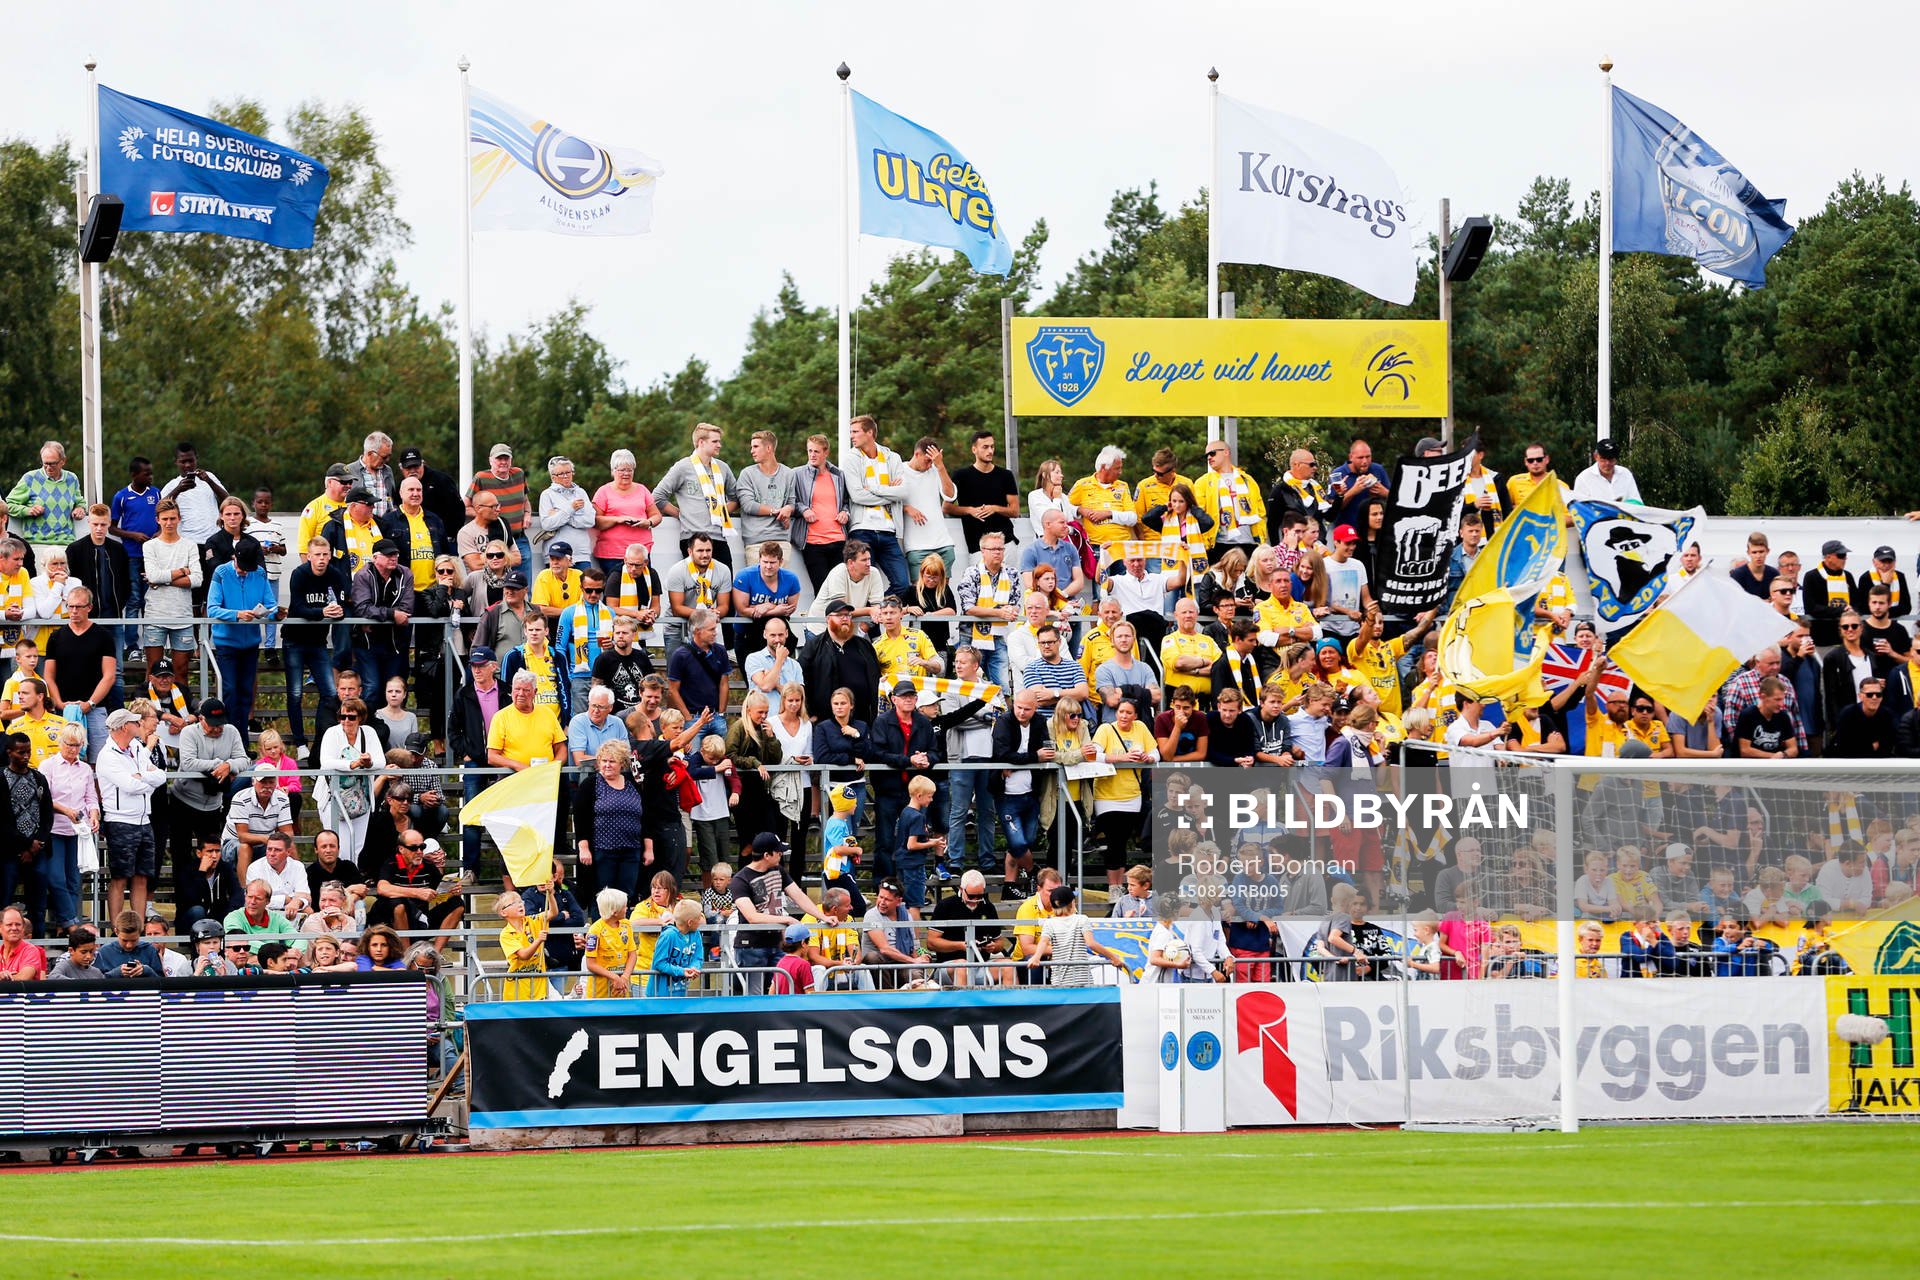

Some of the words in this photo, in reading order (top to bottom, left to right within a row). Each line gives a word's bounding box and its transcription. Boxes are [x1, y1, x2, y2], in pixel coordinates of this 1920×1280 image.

[156, 127, 200, 148] HELA
[205, 134, 281, 161] SVERIGES
[152, 144, 282, 179] FOTBOLLSKLUBB
[539, 195, 612, 221] ALLSVENSKAN
[1057, 383, 1080, 392] 1928
[1125, 351, 1205, 393] Laget
[1213, 352, 1255, 381] vid
[1260, 351, 1333, 382] havet
[1381, 592, 1424, 605] SINCE
[598, 1022, 1049, 1089] ENGELSONS
[1322, 1003, 1811, 1101] Riksbyggen
